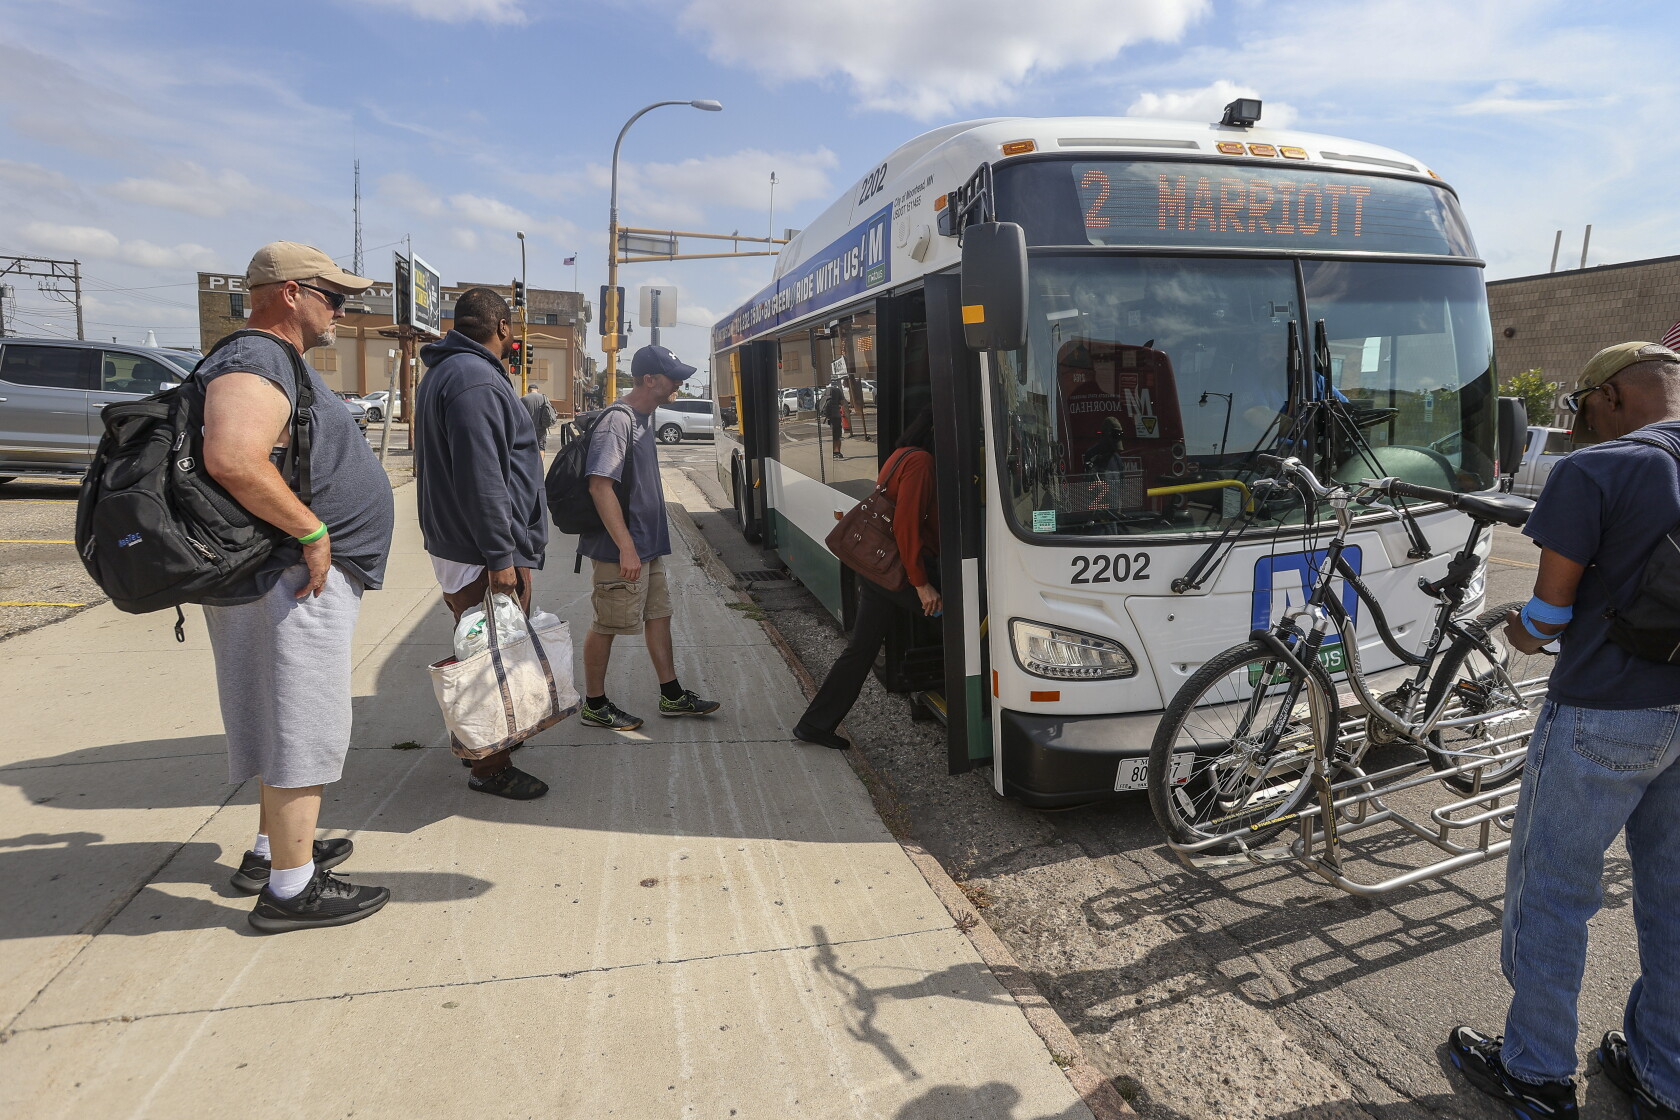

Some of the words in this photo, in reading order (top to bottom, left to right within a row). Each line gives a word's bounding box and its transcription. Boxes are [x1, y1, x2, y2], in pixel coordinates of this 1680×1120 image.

[858, 163, 888, 206] 2202
[1081, 170, 1110, 229] 2
[1158, 173, 1371, 237] MARRIOTT
[868, 221, 884, 266] M
[796, 273, 814, 304] RIDE
[816, 257, 840, 295] WITH
[843, 234, 866, 281] US!
[1088, 480, 1110, 510] 2
[1070, 552, 1151, 584] 2202
